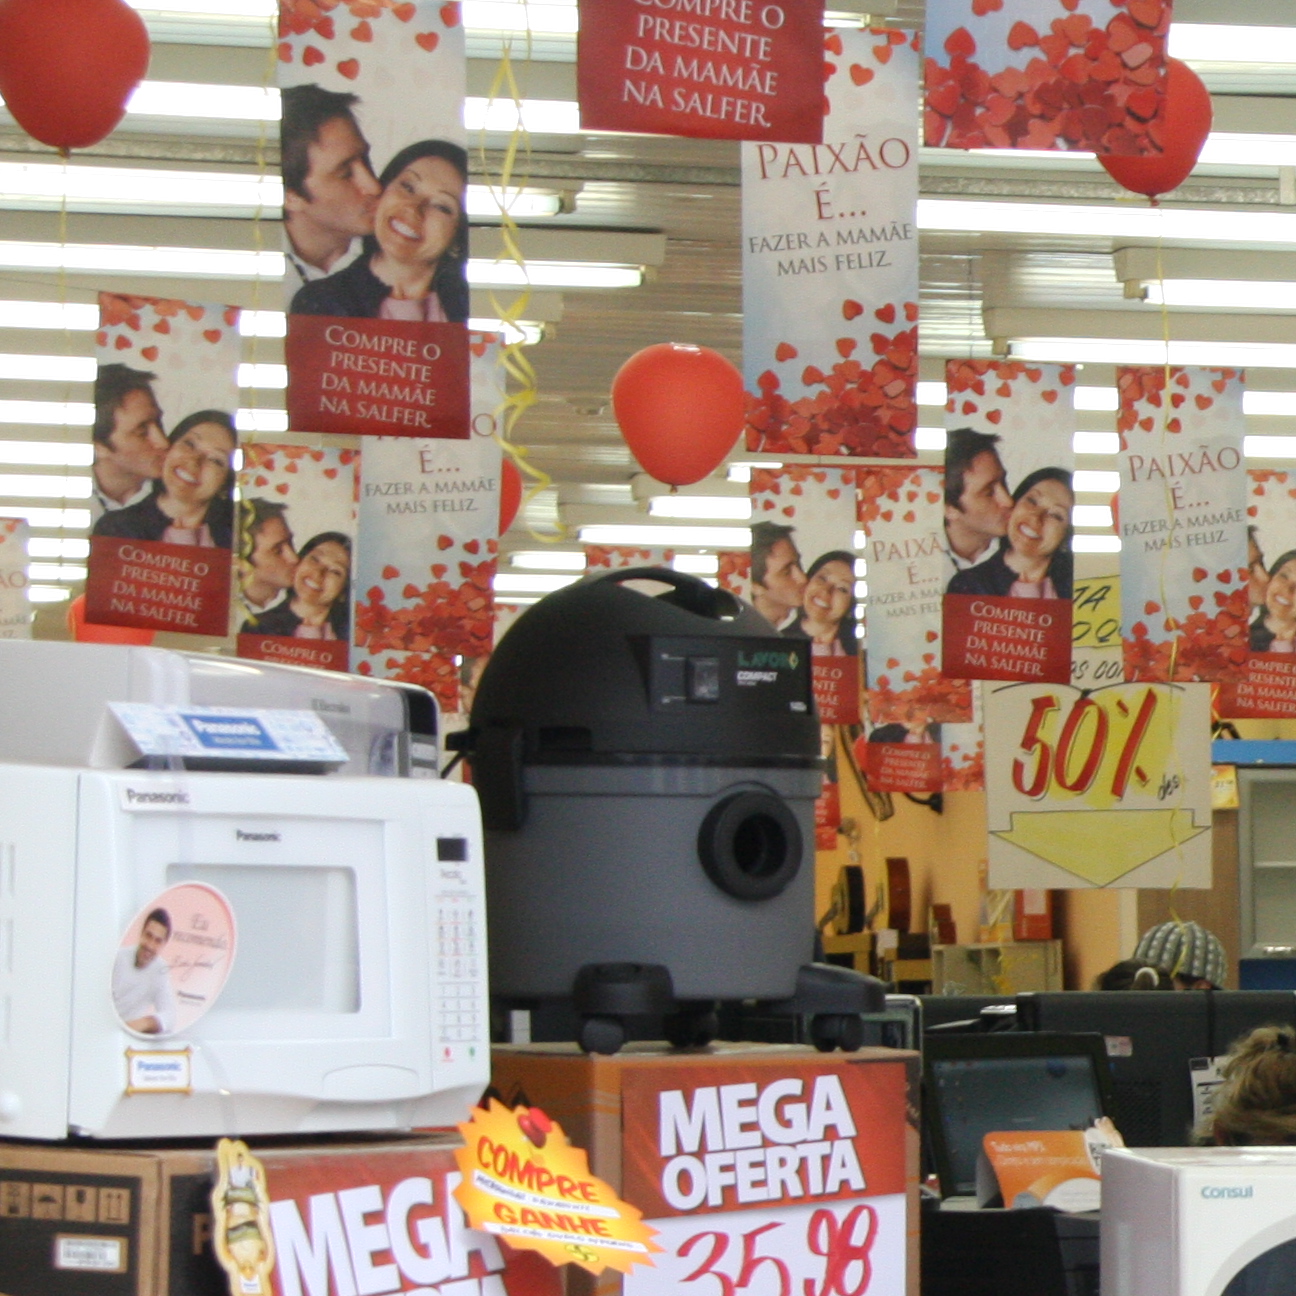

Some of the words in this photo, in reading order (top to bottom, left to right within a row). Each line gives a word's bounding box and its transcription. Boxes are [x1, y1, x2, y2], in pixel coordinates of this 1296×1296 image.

[762, 5, 785, 29] O
[638, 14, 772, 61] PRESENTE
[625, 46, 666, 74] DA
[673, 55, 778, 95] MAMÃE
[622, 79, 663, 108] NA
[672, 88, 771, 128] SALFER.
[756, 133, 910, 180] PAIXÃO
[814, 182, 866, 220] É...
[749, 231, 809, 254] FAZER
[815, 231, 830, 246] A
[836, 222, 914, 246] MAMÃE
[777, 256, 828, 277] MAIS
[325, 325, 416, 356] COMPRE
[423, 343, 440, 360] O
[330, 351, 431, 382] PRESENTE
[321, 373, 350, 392] DA
[358, 380, 436, 406] MAMÃE
[320, 395, 350, 415] NA
[357, 401, 431, 428] SALFER.
[1128, 446, 1240, 481] PAIXÃO
[364, 483, 412, 497] FAZER
[418, 483, 430, 495] A
[434, 477, 496, 494] MAMÃE
[386, 500, 426, 515] MAIS
[1123, 519, 1165, 536] FAZER
[1172, 518, 1183, 529] A
[1187, 507, 1244, 527] MAMÃE
[119, 545, 190, 572] COMPRE
[193, 561, 209, 576] O
[1144, 538, 1181, 552] MAIS
[122, 565, 200, 592] PRESENTE
[110, 599, 134, 614] NA
[112, 581, 135, 596] DA
[140, 586, 202, 611] MAMÃE
[970, 601, 1037, 625] COMPRE
[1039, 614, 1052, 627] O
[974, 620, 1045, 642] PRESENTE
[964, 652, 987, 665] NA
[966, 635, 989, 650] DA
[992, 639, 1047, 660] MAMÃE
[1012, 688, 1158, 800] 50%
[126, 788, 191, 805] Panasonic
[236, 829, 281, 842] Panasonic
[659, 1074, 857, 1156] MEGA
[476, 1135, 601, 1203] COMPRE
[661, 1138, 866, 1211] OFERTA
[1201, 1185, 1253, 1200] Consul
[493, 1202, 612, 1239] GANHE
